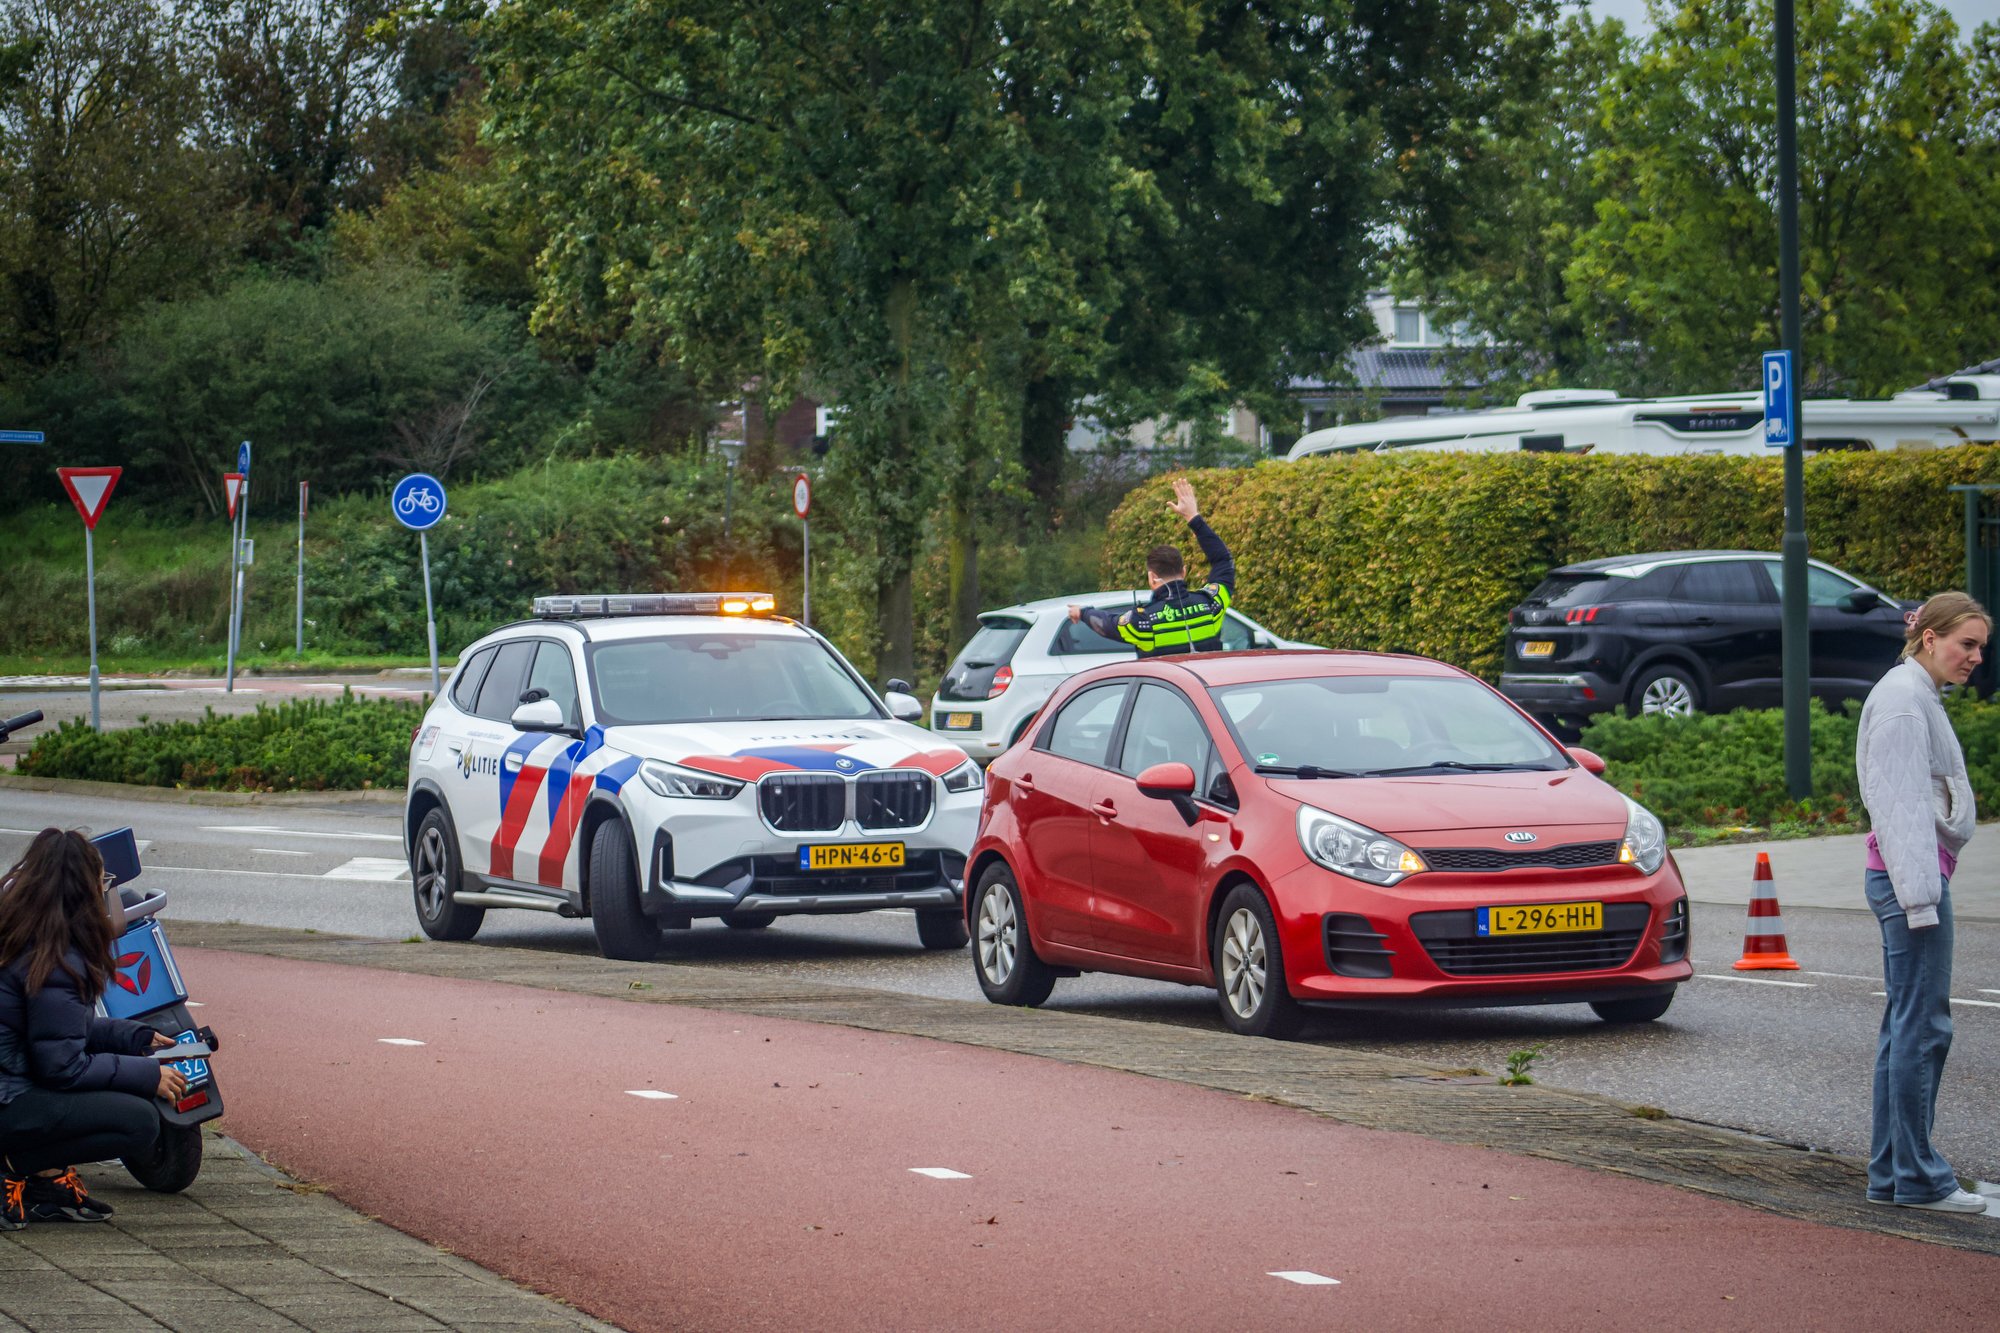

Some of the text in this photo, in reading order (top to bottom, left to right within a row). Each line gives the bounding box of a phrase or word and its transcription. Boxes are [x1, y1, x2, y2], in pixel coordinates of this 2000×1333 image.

[1768, 361, 1782, 406] P
[1156, 603, 1206, 621] POLITIE
[457, 753, 497, 779] POLITIE
[815, 846, 900, 865] HPN-46-G
[1495, 906, 1595, 931] L-296-HH
